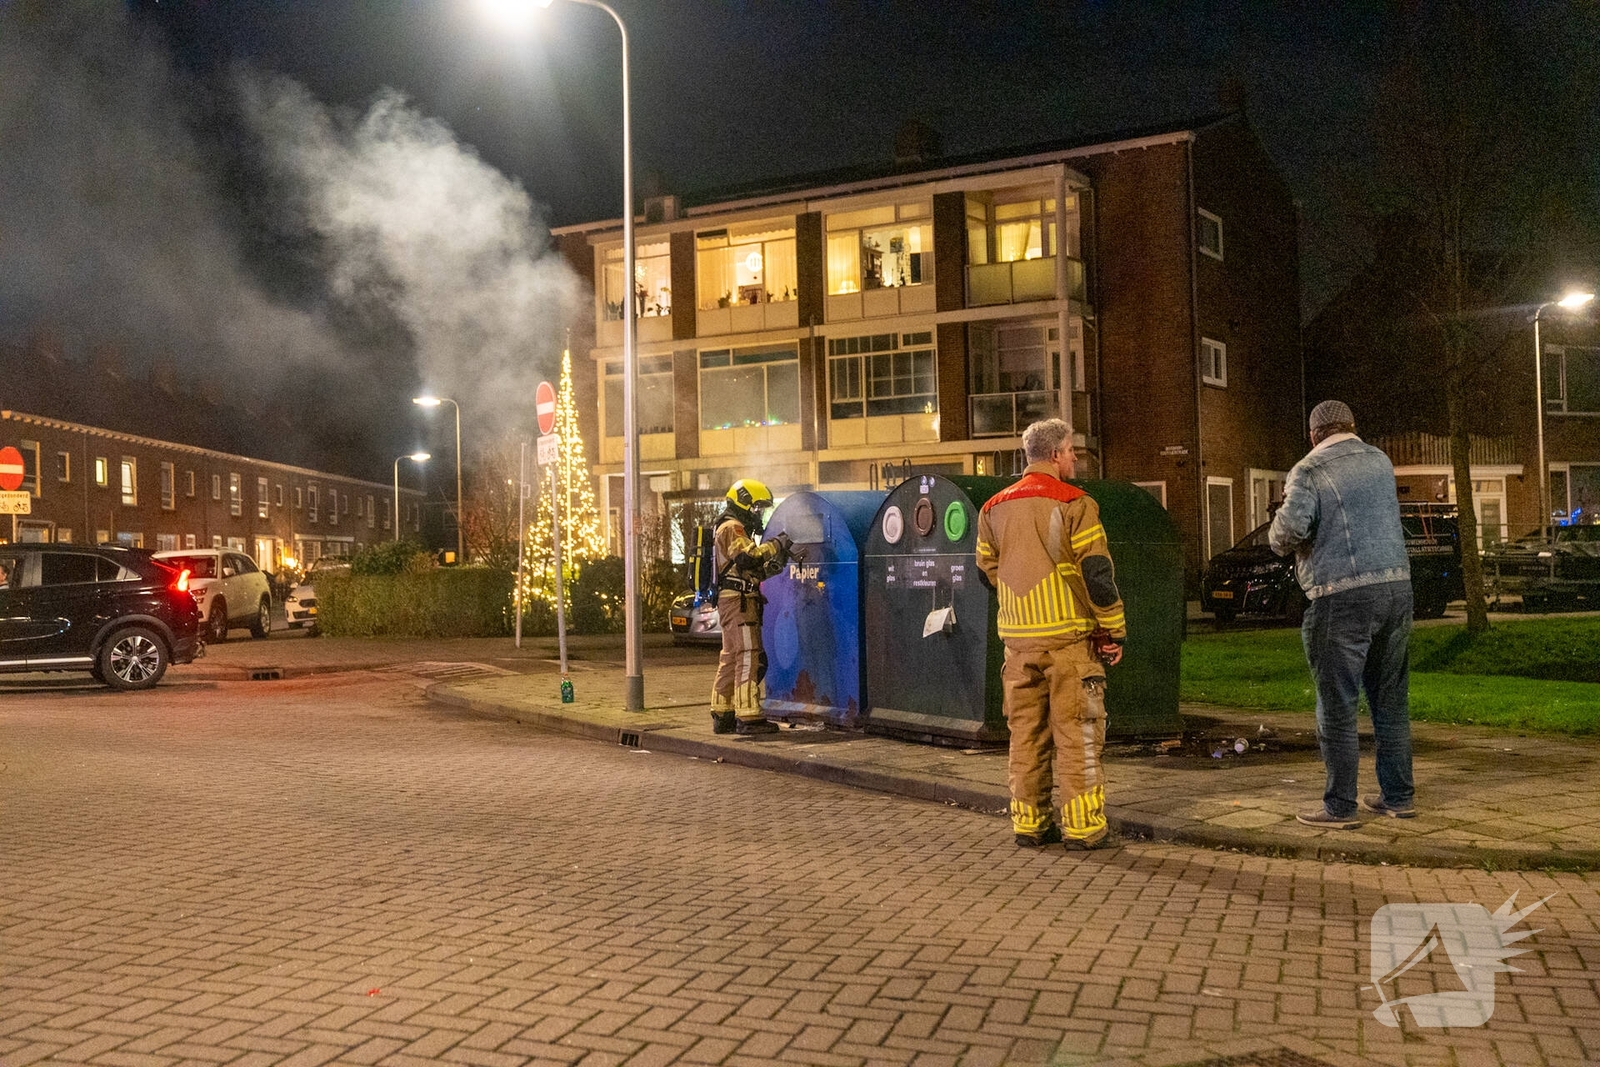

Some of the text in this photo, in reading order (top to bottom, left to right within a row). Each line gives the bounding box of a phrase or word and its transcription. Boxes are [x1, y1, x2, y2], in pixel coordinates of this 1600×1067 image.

[926, 560, 935, 569] glas
[790, 564, 820, 583] Papier
[886, 575, 896, 583] glas
[952, 575, 962, 583] glas
